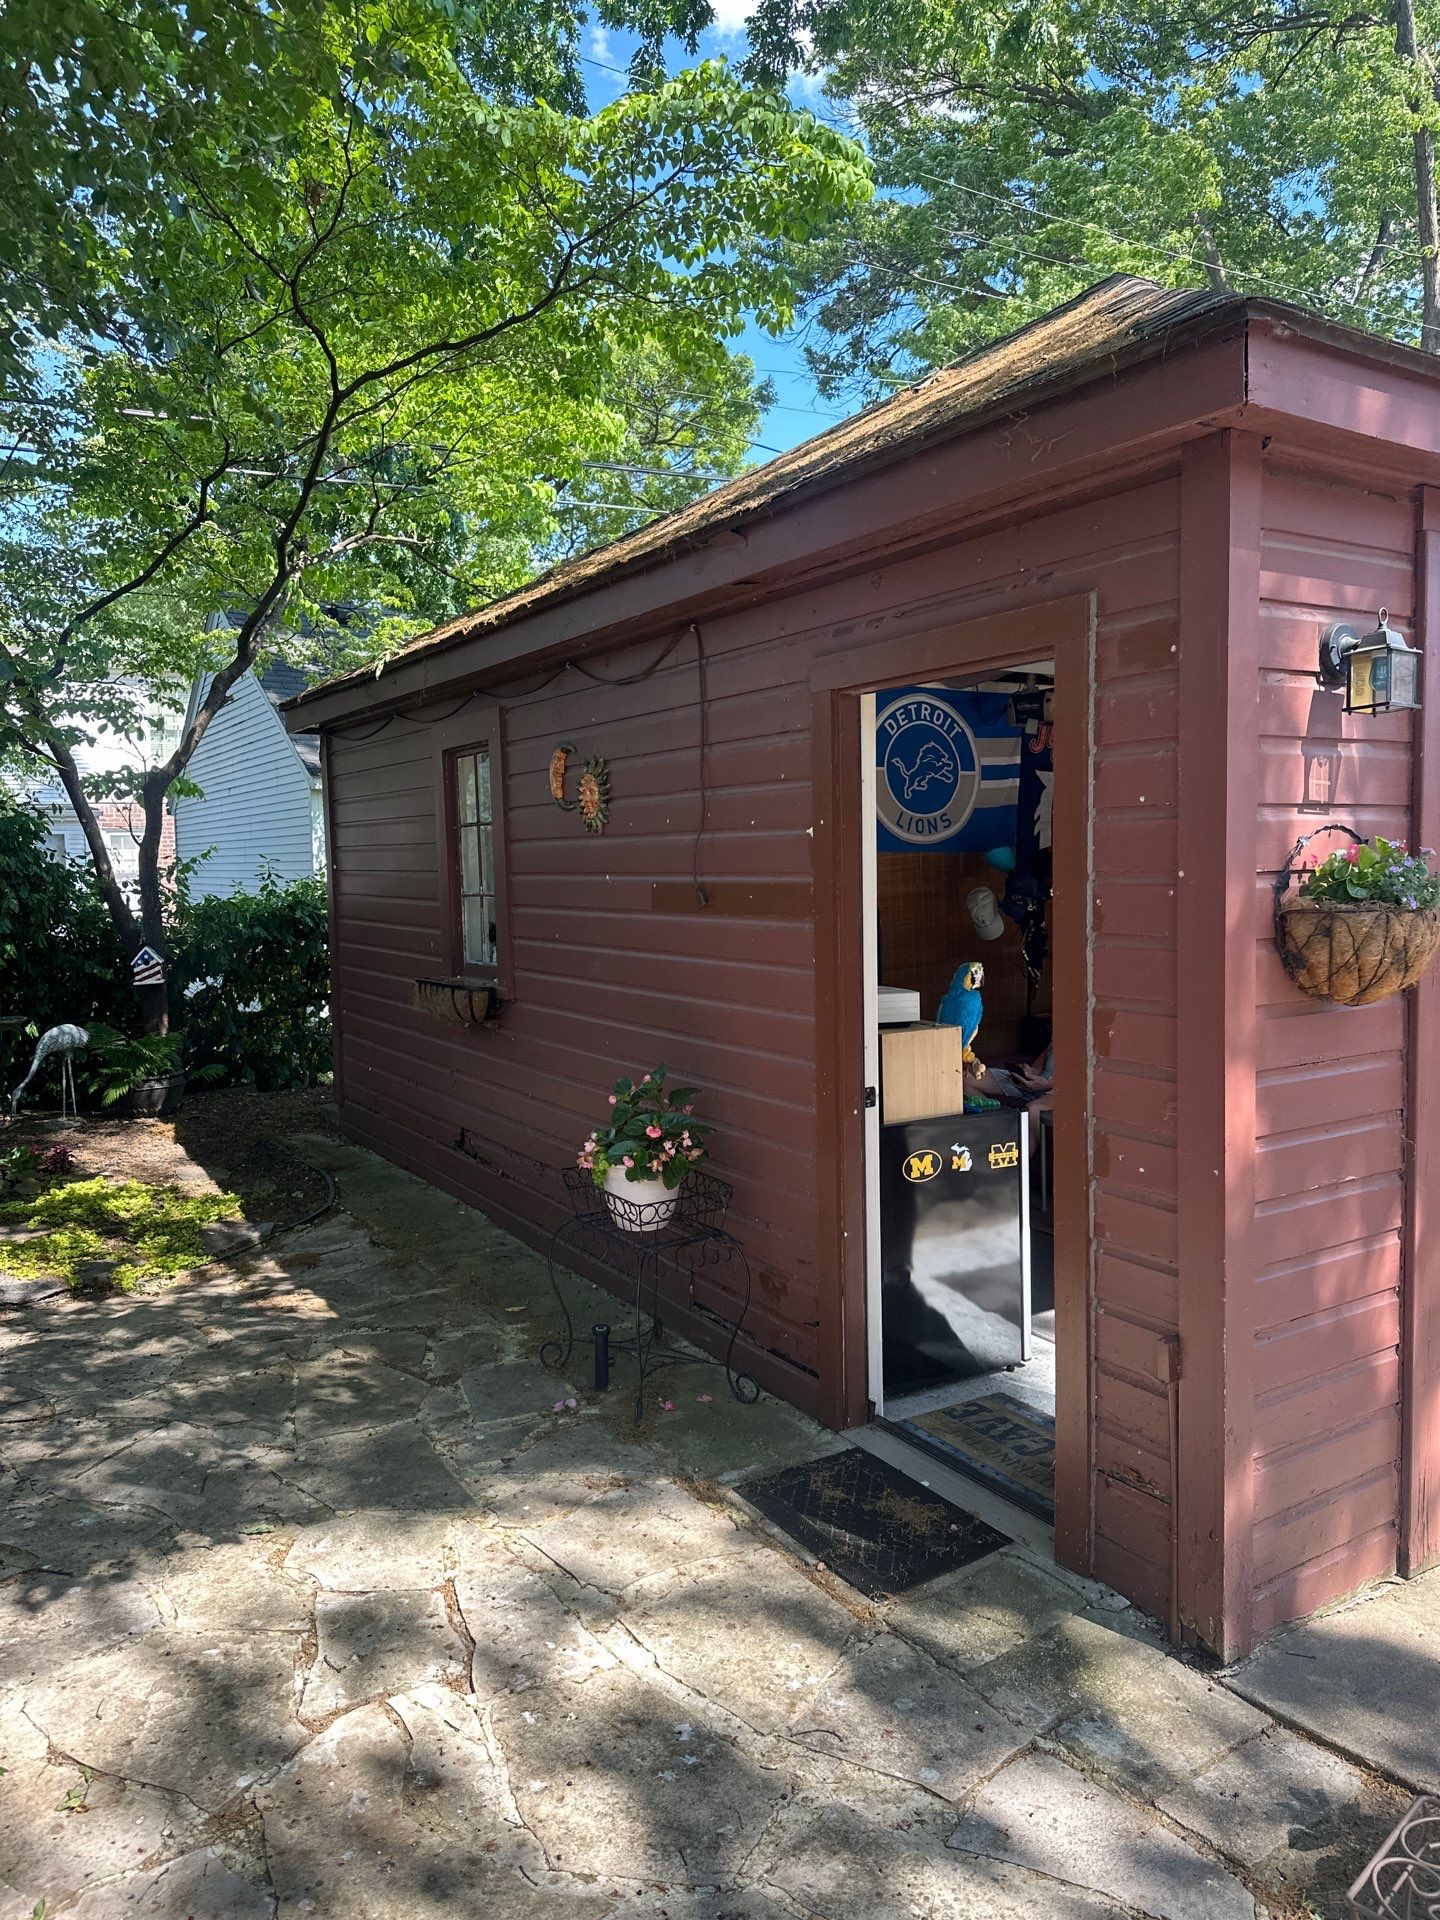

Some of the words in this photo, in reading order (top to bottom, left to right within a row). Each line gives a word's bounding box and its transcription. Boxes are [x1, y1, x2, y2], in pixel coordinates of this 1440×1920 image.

[884, 703, 962, 736] DETROIT
[896, 812, 951, 834] LIONS
[910, 1154, 934, 1178] M
[952, 1155, 966, 1169] M
[942, 1402, 1055, 1456] CAVE
